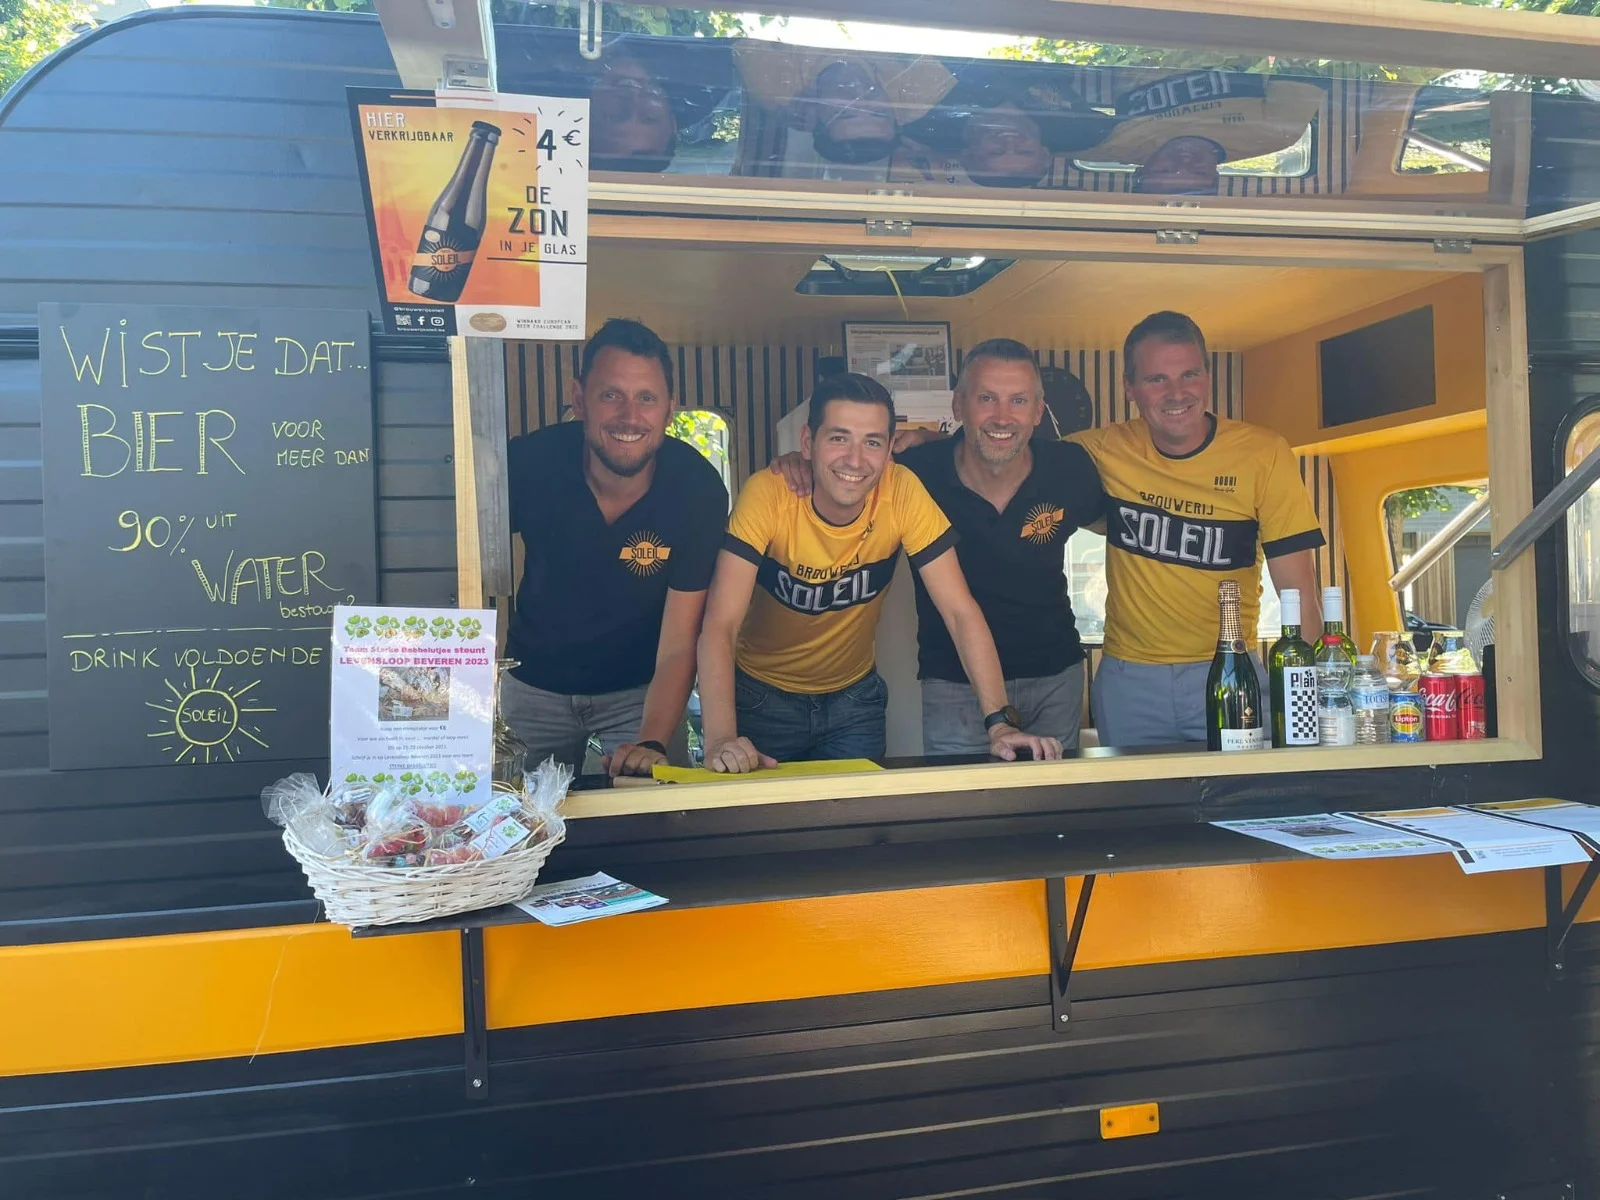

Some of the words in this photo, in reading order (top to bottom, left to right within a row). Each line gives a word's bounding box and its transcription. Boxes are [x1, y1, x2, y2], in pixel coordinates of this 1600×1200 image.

[365, 112, 406, 129] HIER
[368, 130, 454, 142] VERKRIJGBAAR
[526, 186, 551, 205] DE
[507, 207, 569, 237] ZON
[500, 240, 513, 251] IN
[521, 242, 536, 253] JE
[544, 243, 577, 256] GLAS
[431, 253, 461, 266] SOLEIL
[203, 332, 258, 373] JE
[77, 404, 246, 477] BIER
[272, 419, 326, 441] VOOR
[276, 448, 325, 468] MEER
[335, 447, 370, 465] DAN
[107, 510, 195, 557] 90%
[1030, 513, 1057, 533] SOLEIL
[1119, 506, 1232, 565] SOLEIL
[631, 546, 661, 560] SOLEIL
[191, 549, 345, 606] WATER
[774, 569, 877, 612] SOLEIL
[174, 646, 323, 669] VOLDOENDE
[413, 657, 463, 665] BEVEREN
[465, 657, 489, 666] 2023
